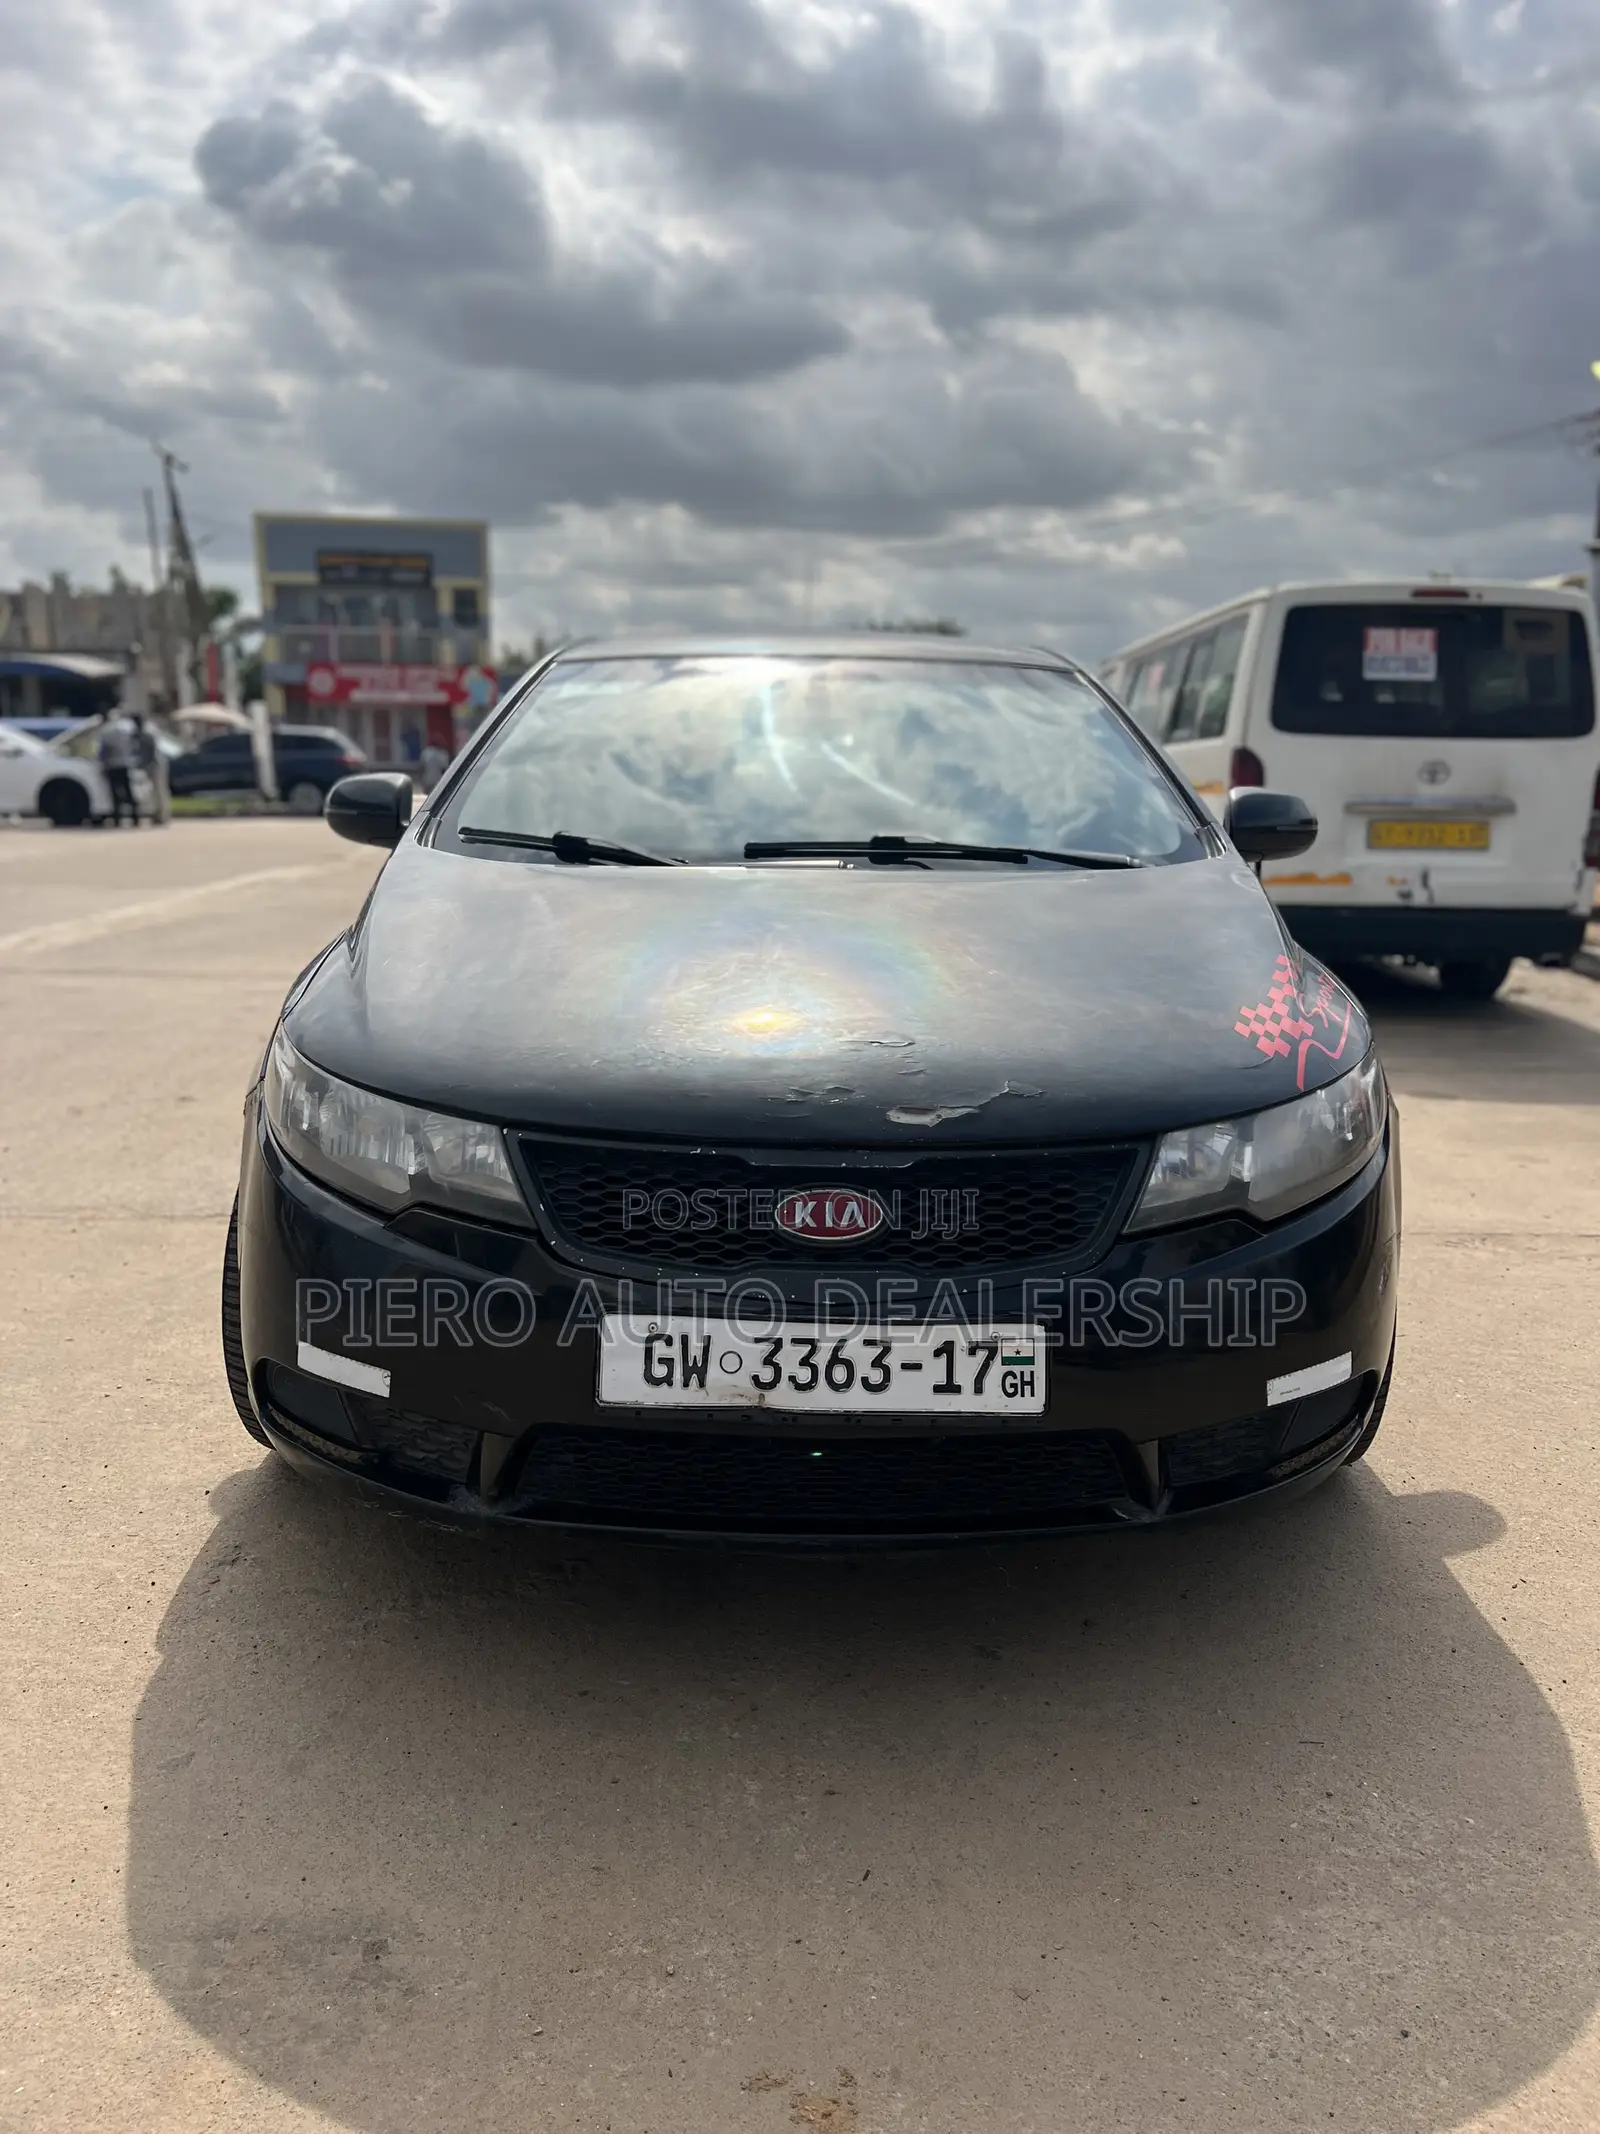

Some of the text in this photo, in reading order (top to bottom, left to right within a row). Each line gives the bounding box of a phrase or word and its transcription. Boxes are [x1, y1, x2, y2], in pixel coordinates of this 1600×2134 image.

[793, 1200, 867, 1229] KIA
[643, 1333, 998, 1394] GW 3363-17
[1001, 1371, 1035, 1398] GH
